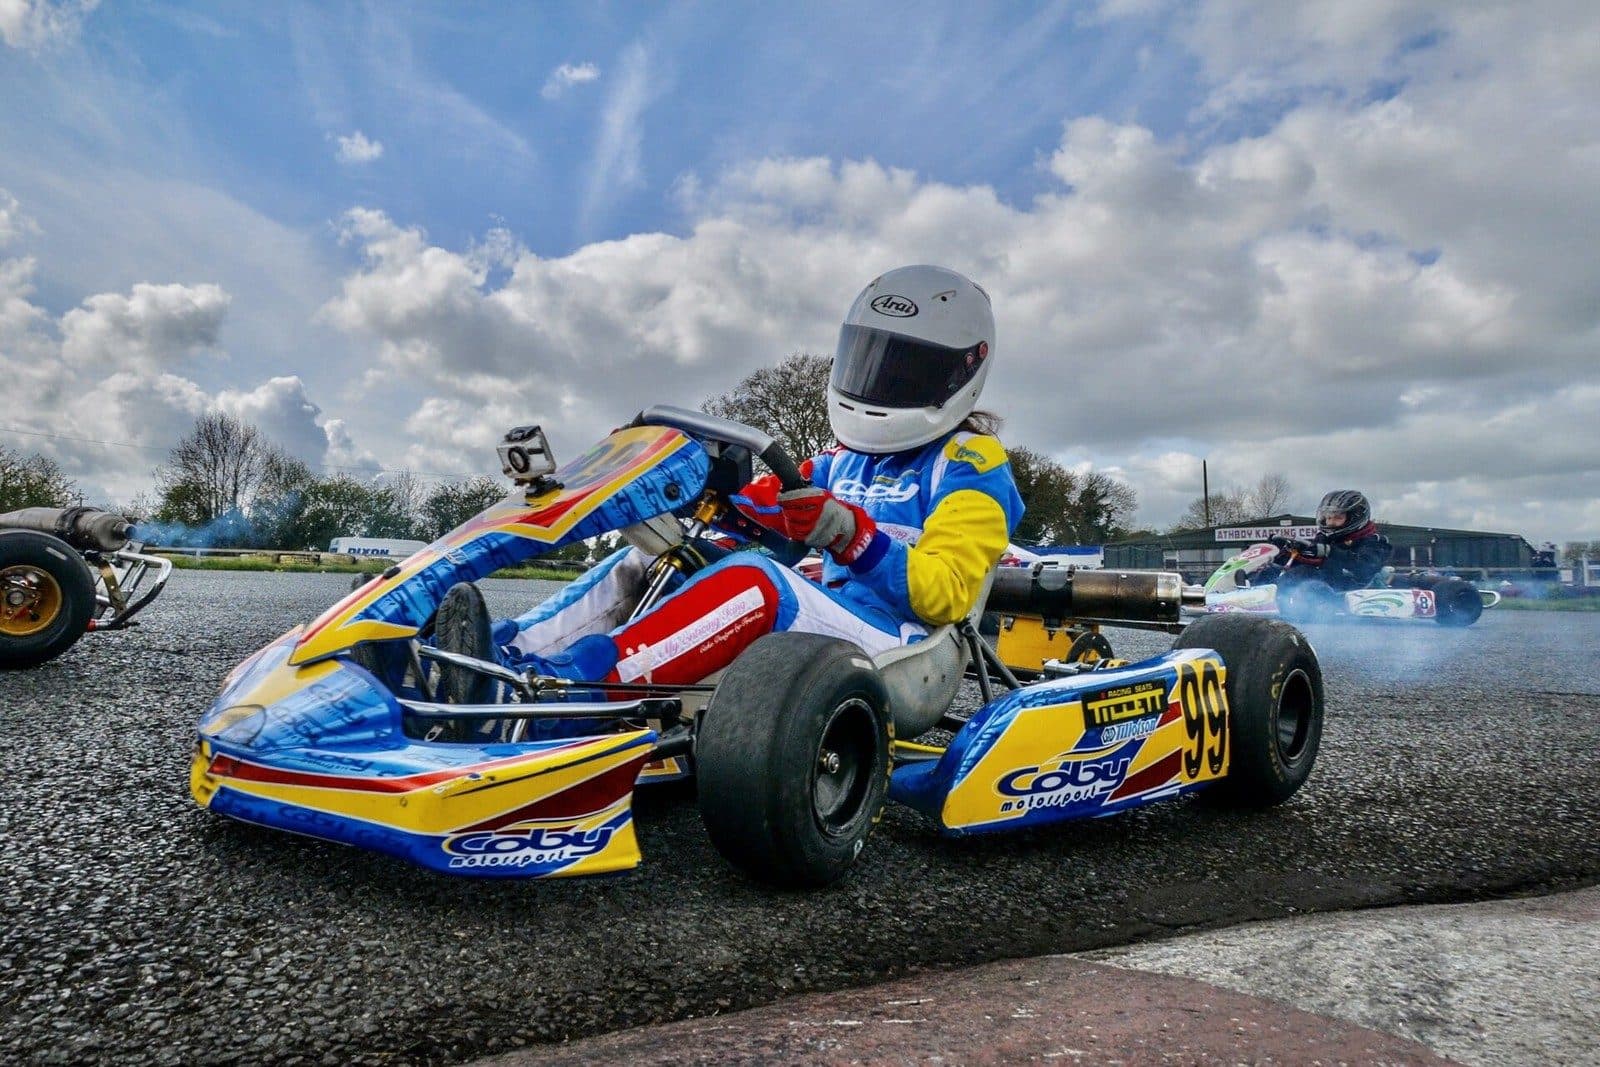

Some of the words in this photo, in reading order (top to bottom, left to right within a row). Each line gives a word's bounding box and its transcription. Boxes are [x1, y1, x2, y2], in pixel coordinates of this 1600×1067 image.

[873, 296, 912, 313] Arai
[1217, 529, 1252, 539] ATHBOY
[1255, 527, 1297, 540] KARTING
[347, 547, 389, 556] DIXON
[1420, 596, 1428, 609] 8
[1107, 687, 1132, 698] RACING
[1134, 683, 1153, 694] SEATS
[1087, 688, 1164, 724] TILLETT
[1180, 661, 1227, 779] 99
[1000, 784, 1097, 812] motorsport
[450, 850, 566, 867] motorsport
